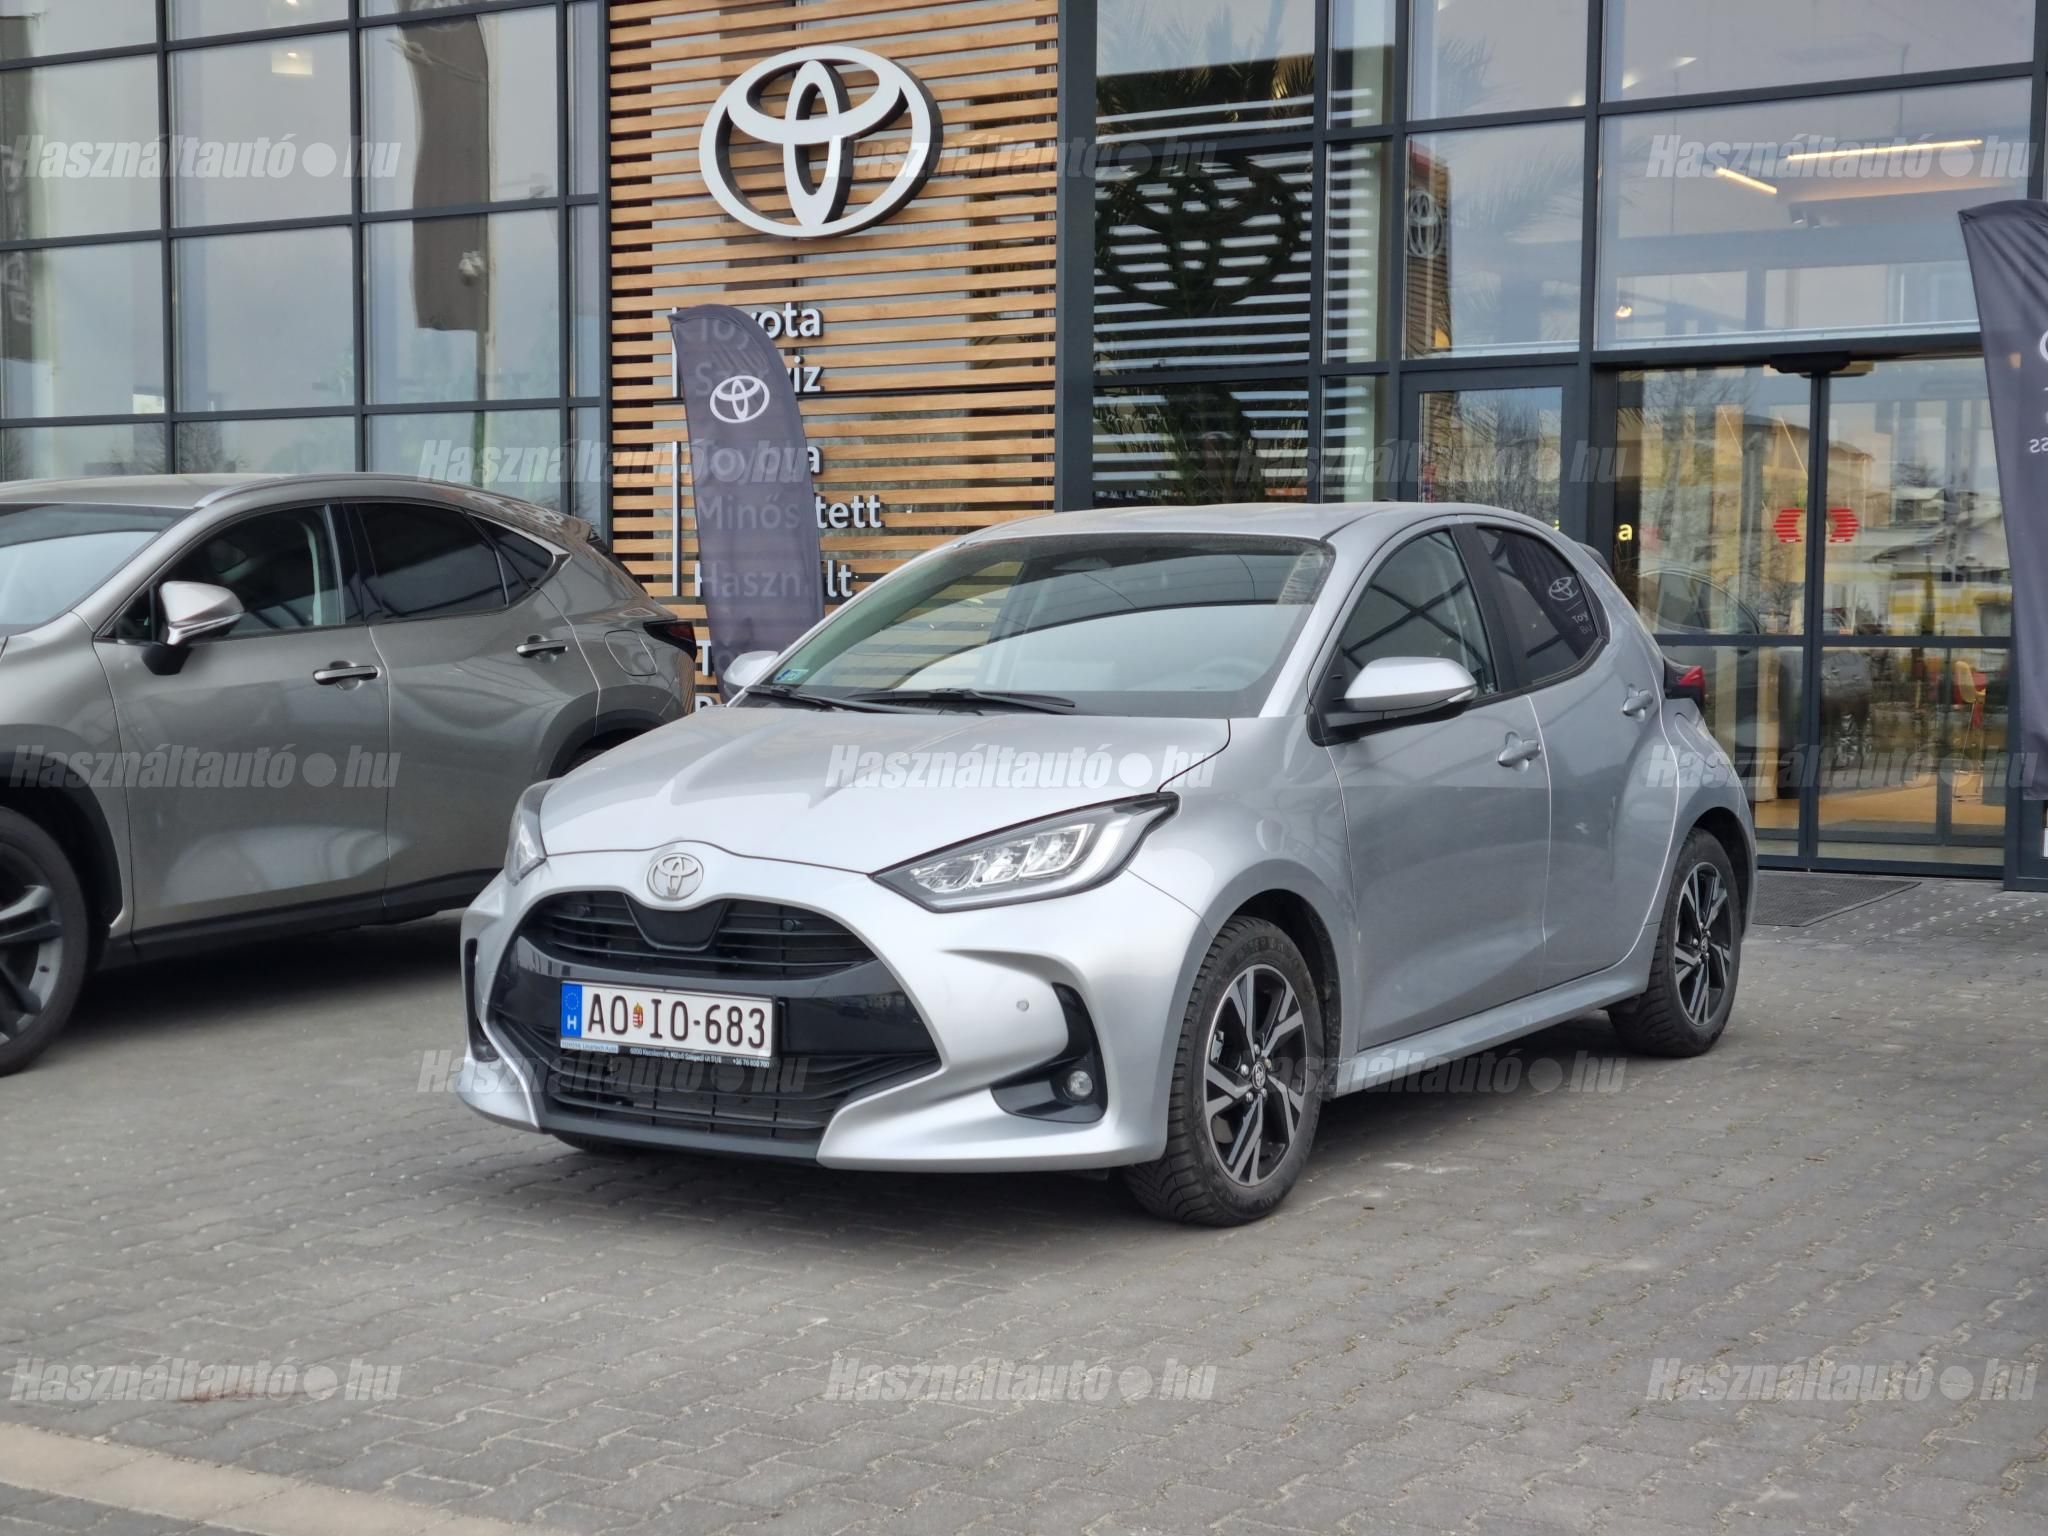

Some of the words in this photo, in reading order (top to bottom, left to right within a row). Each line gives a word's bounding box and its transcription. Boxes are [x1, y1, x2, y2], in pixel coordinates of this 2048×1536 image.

[566, 1015, 577, 1031] H
[587, 993, 629, 1036] AO
[649, 998, 766, 1049] IO-683
